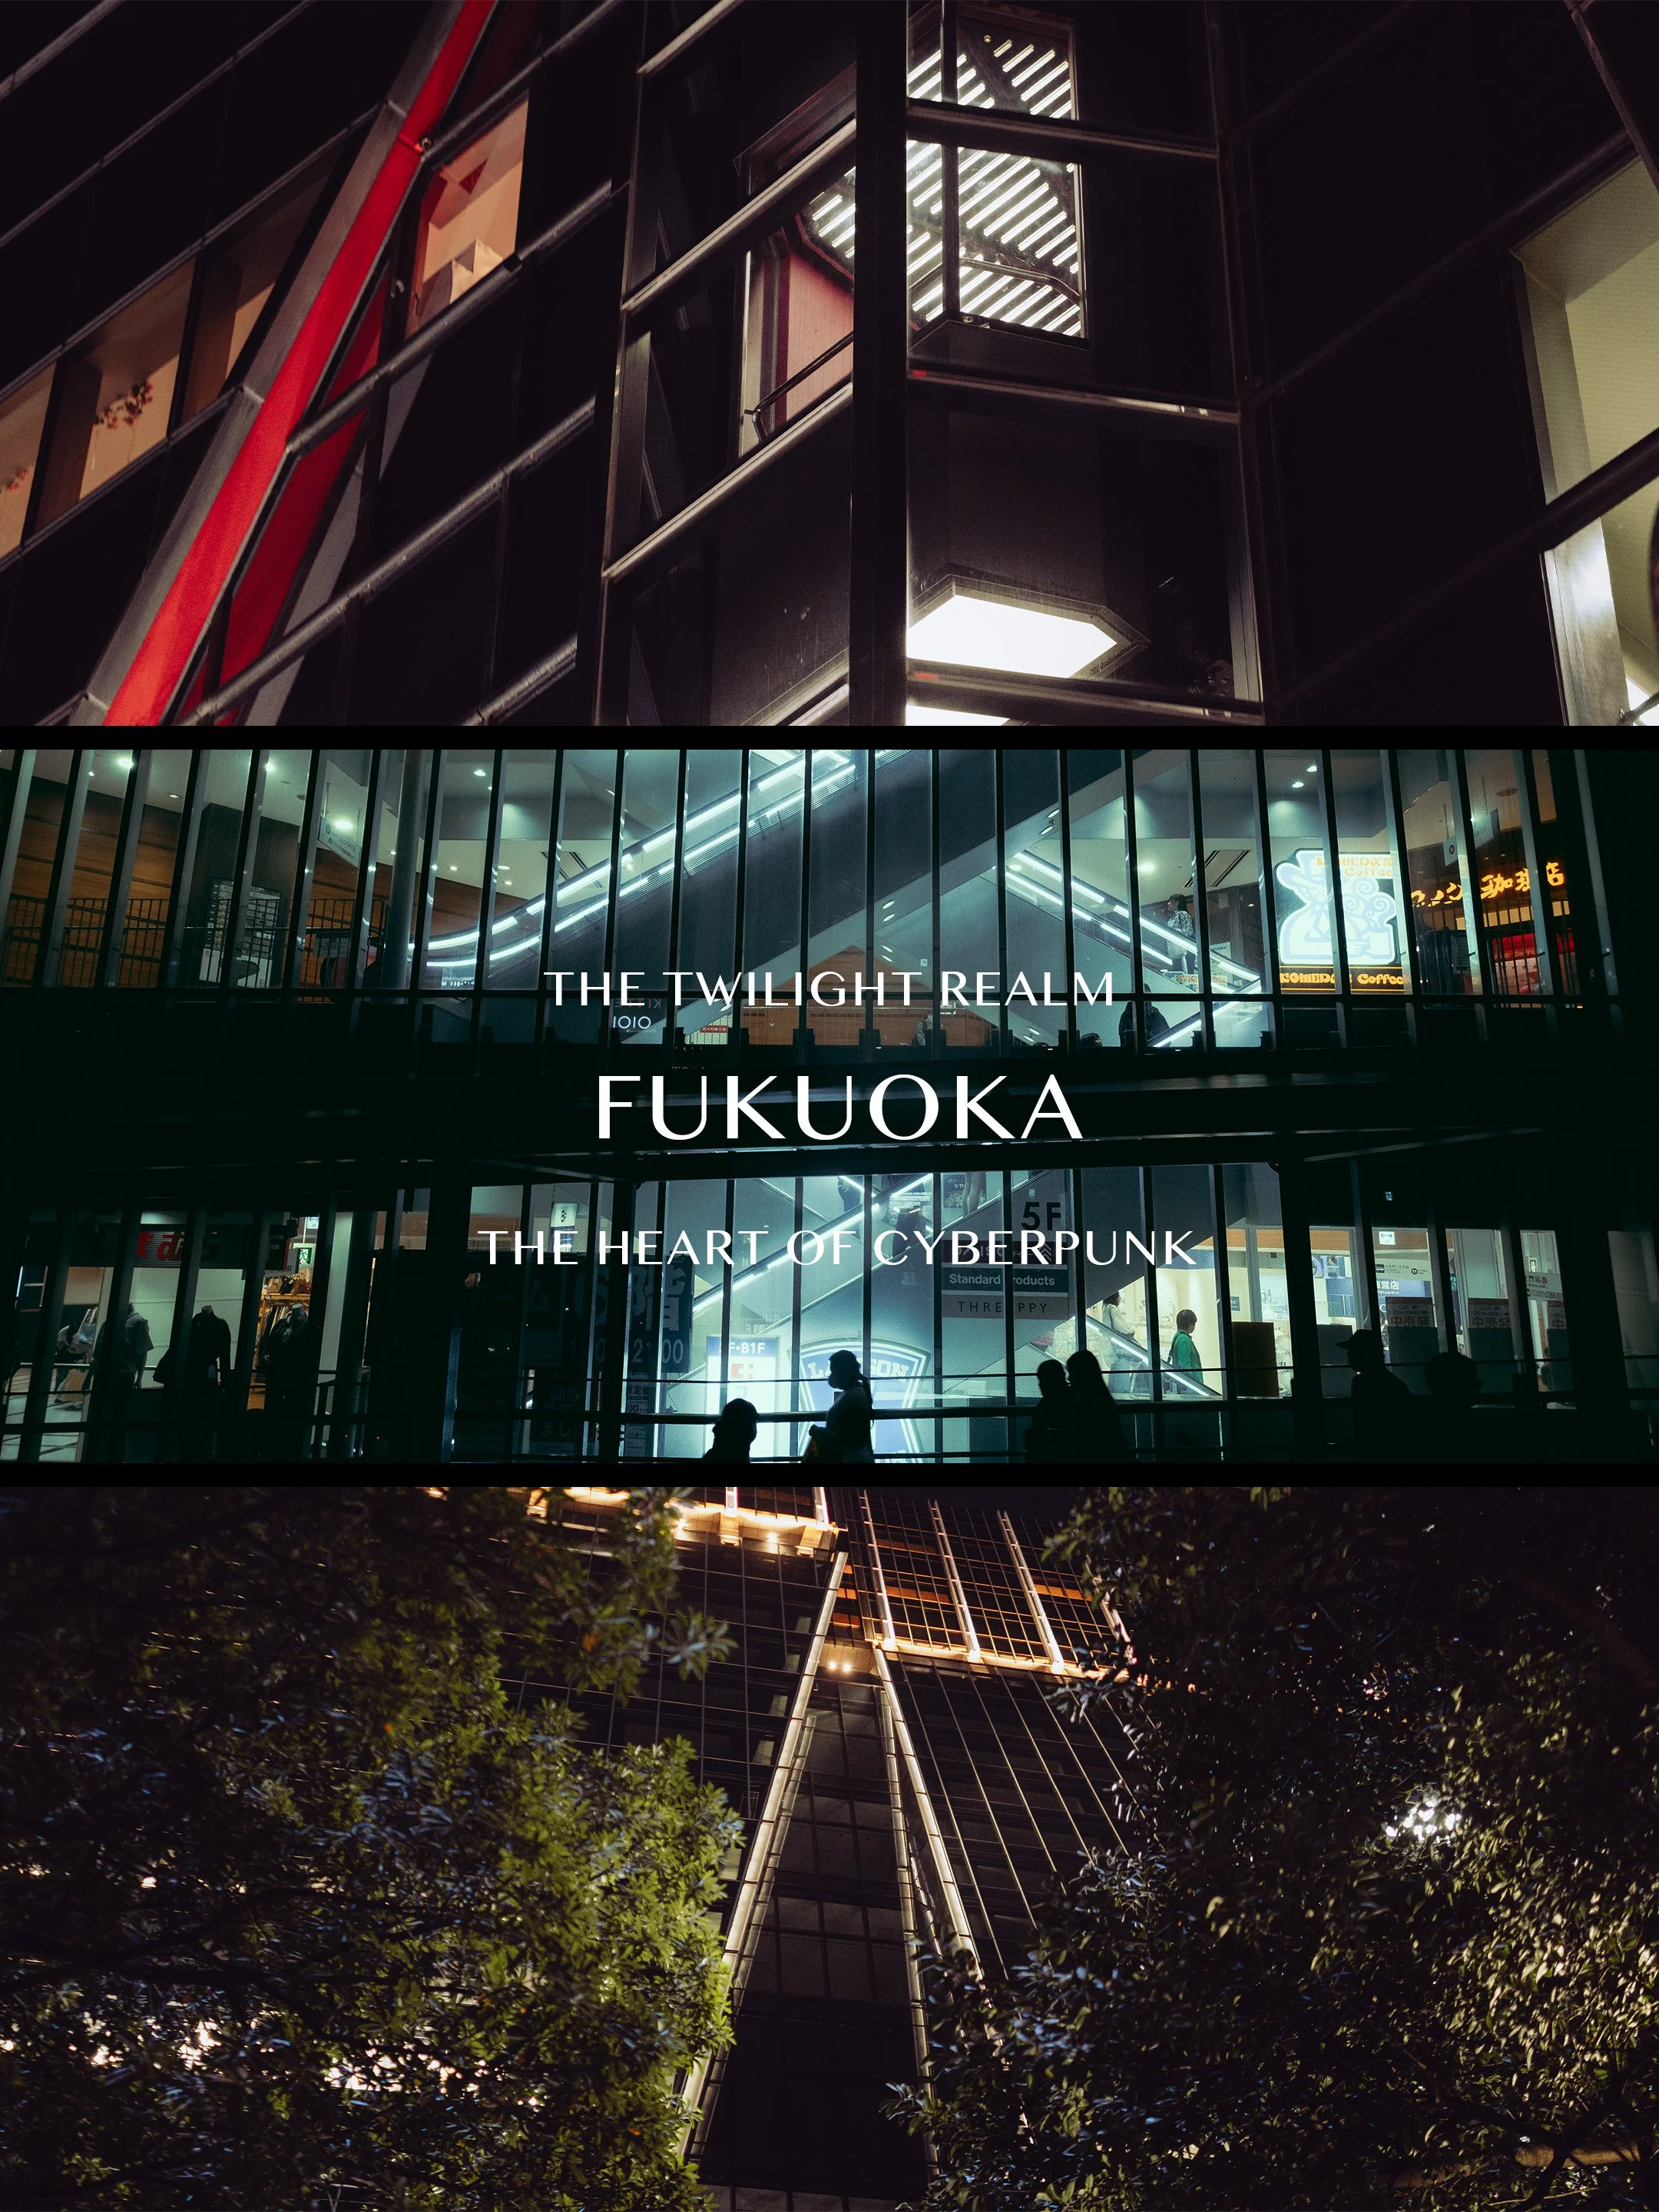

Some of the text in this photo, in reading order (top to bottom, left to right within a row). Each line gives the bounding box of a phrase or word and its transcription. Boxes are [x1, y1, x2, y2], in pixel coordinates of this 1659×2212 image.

[1357, 973, 1407, 985] Coffee
[1021, 1201, 1061, 1230] 5F
[949, 1273, 1055, 1286] Standard roducts
[958, 1301, 1047, 1313] THREPPY
